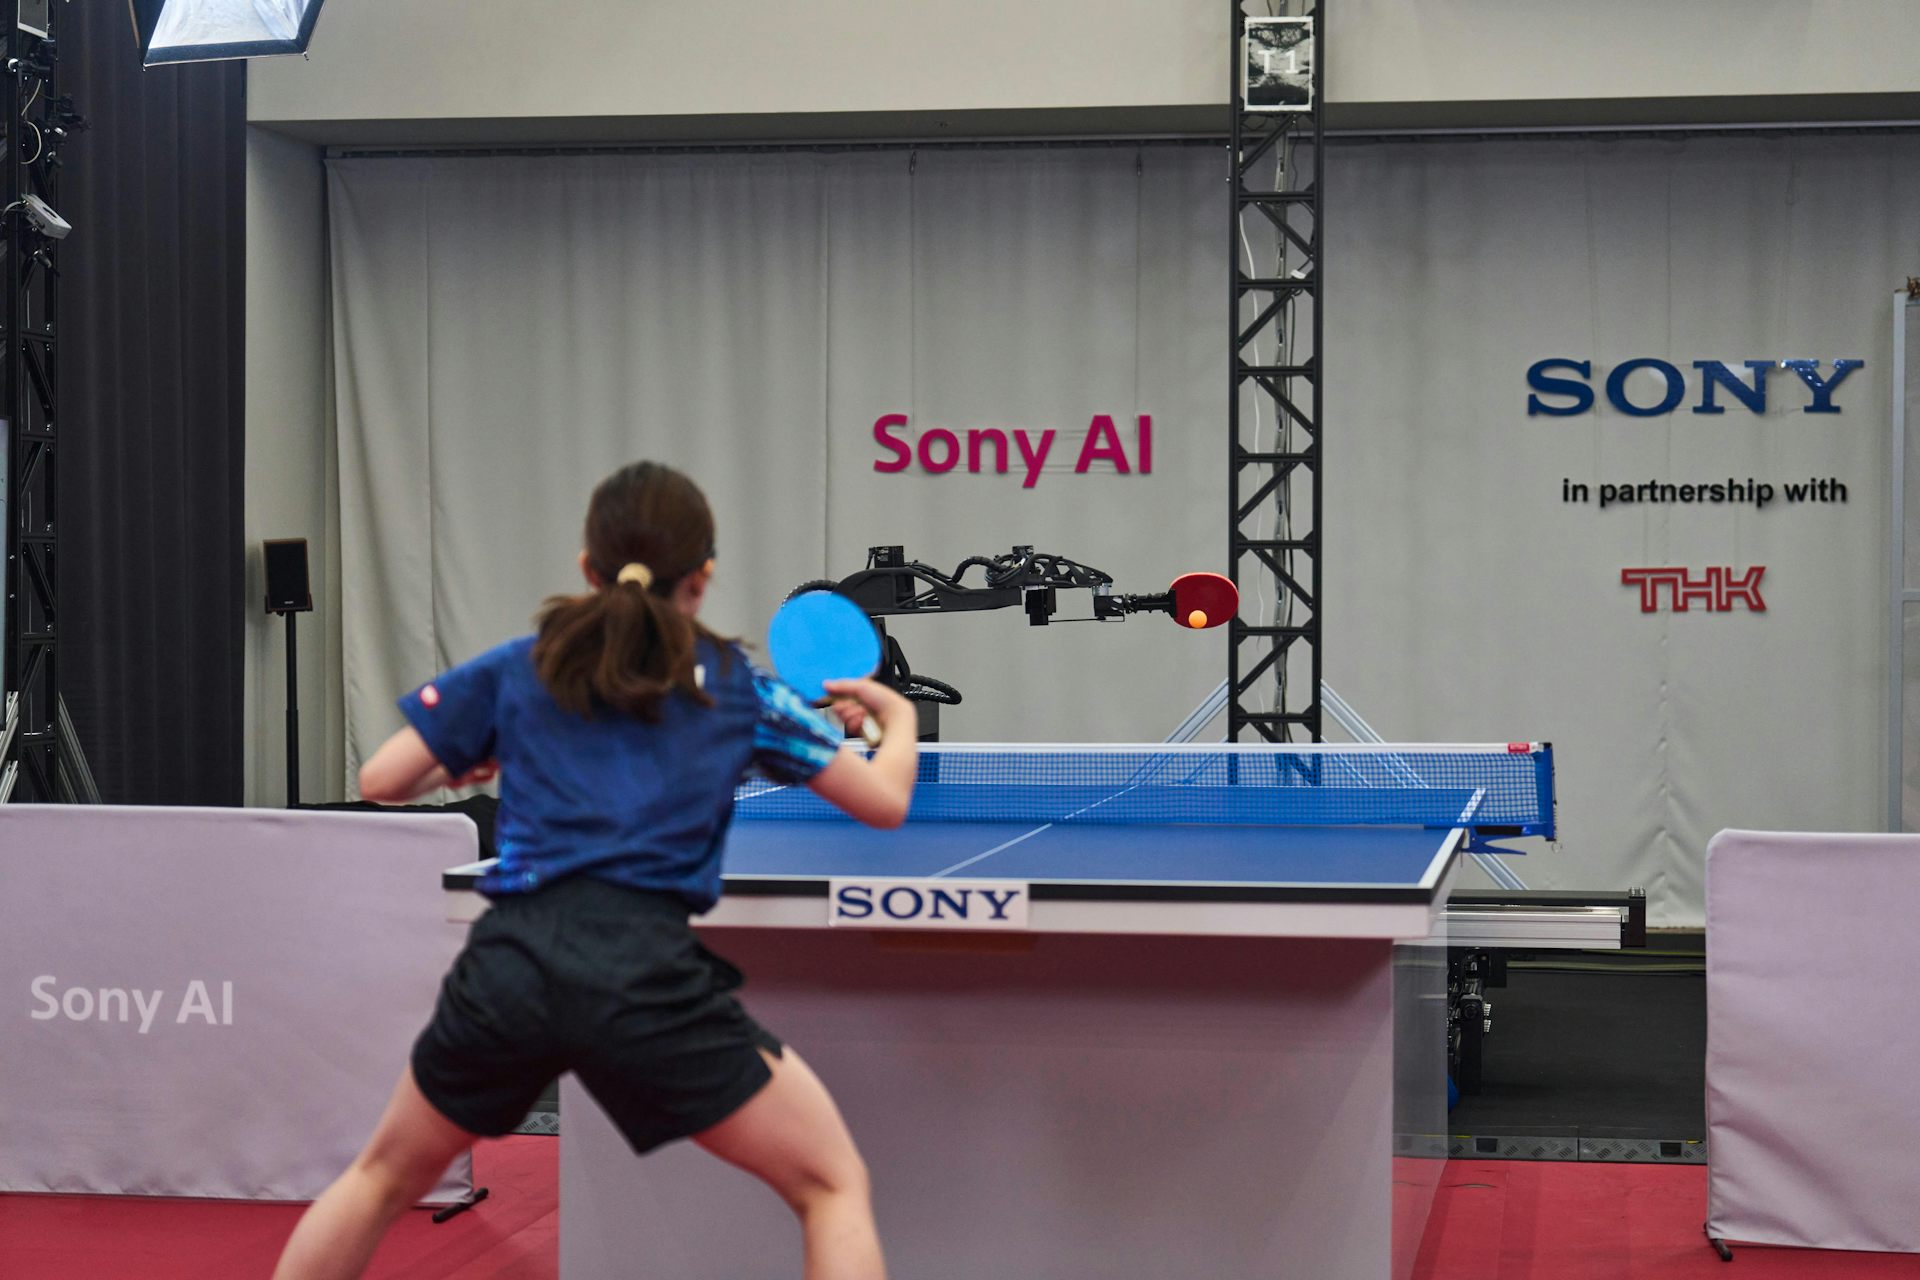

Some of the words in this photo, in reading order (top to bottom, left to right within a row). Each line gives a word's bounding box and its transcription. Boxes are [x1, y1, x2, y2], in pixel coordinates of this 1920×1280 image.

[1526, 358, 1864, 417] SONY
[873, 413, 1057, 489] Sony
[1074, 414, 1152, 474] AI
[1562, 477, 1589, 502] in
[1600, 478, 1775, 509] partnership
[1784, 477, 1848, 502] with
[1621, 566, 1767, 613] THK
[836, 886, 1020, 920] SONY
[30, 975, 164, 1034] Sony
[175, 979, 233, 1025] AI
